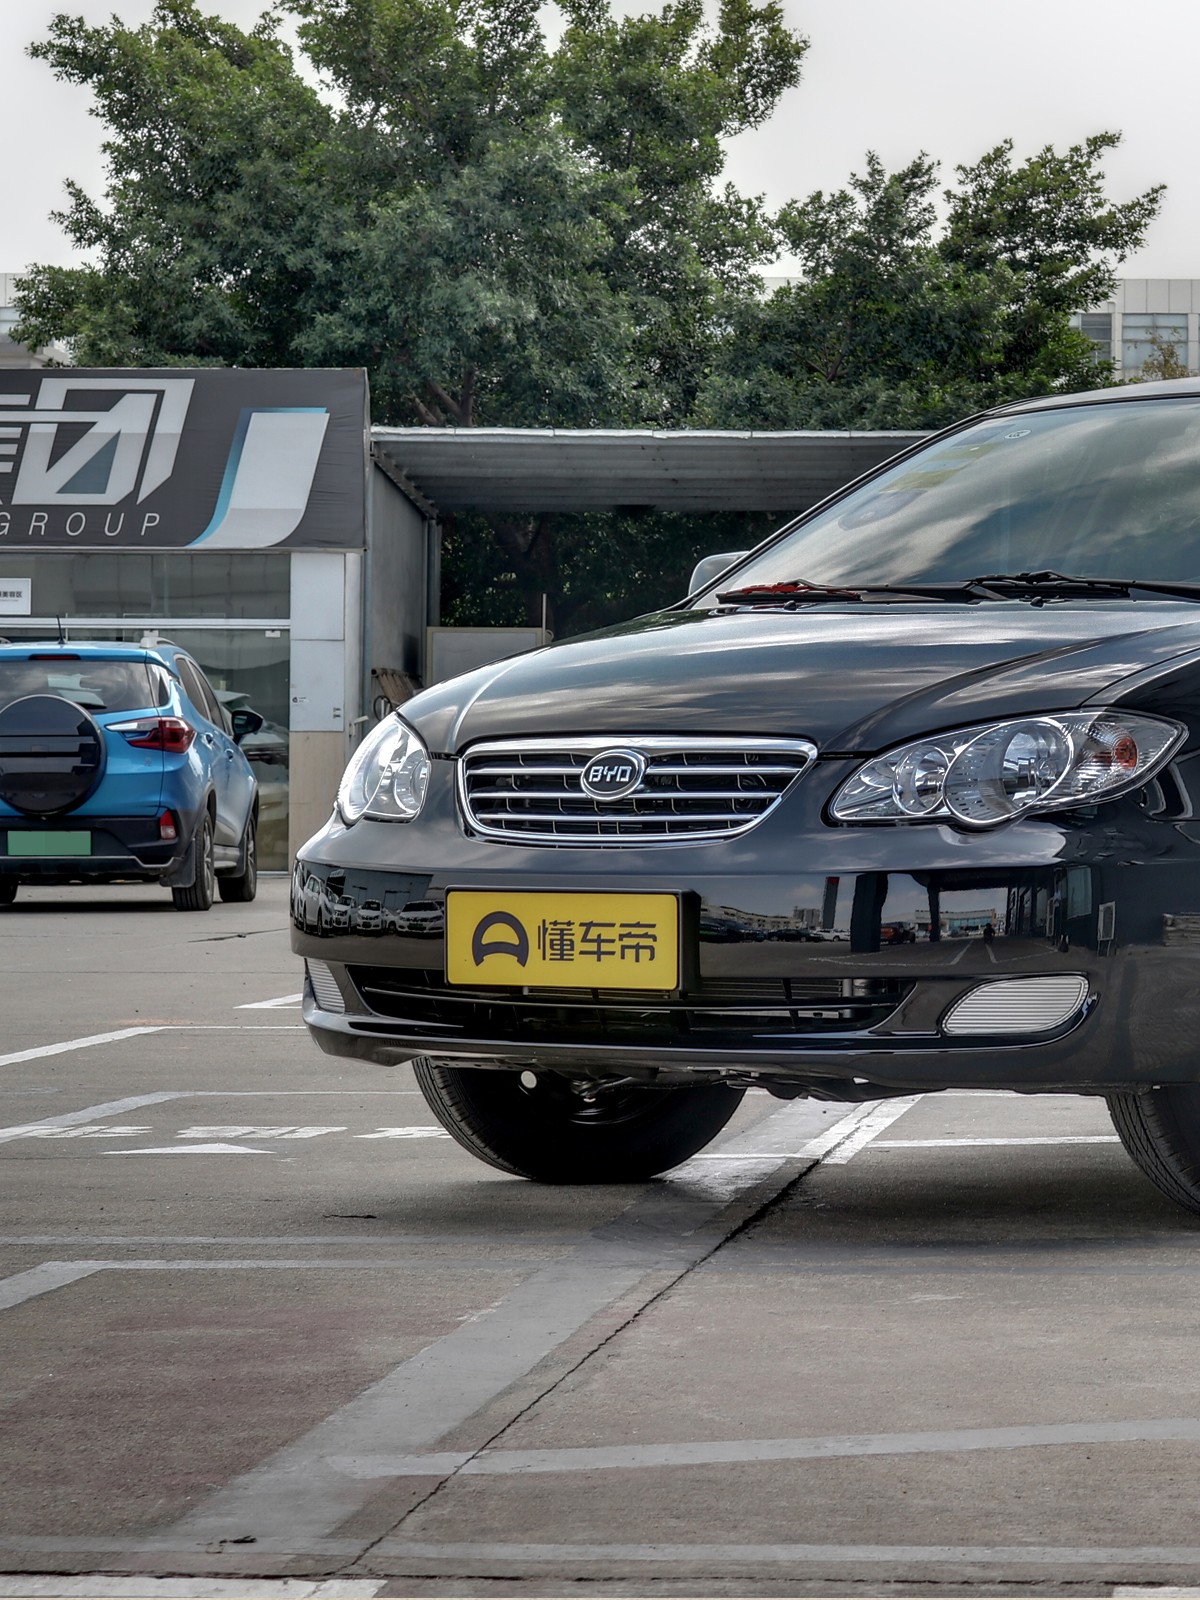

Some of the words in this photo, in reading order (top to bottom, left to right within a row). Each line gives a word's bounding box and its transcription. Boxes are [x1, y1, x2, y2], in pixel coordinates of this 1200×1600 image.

[588, 766, 632, 782] BYD
[537, 918, 658, 963] 懂车帝
